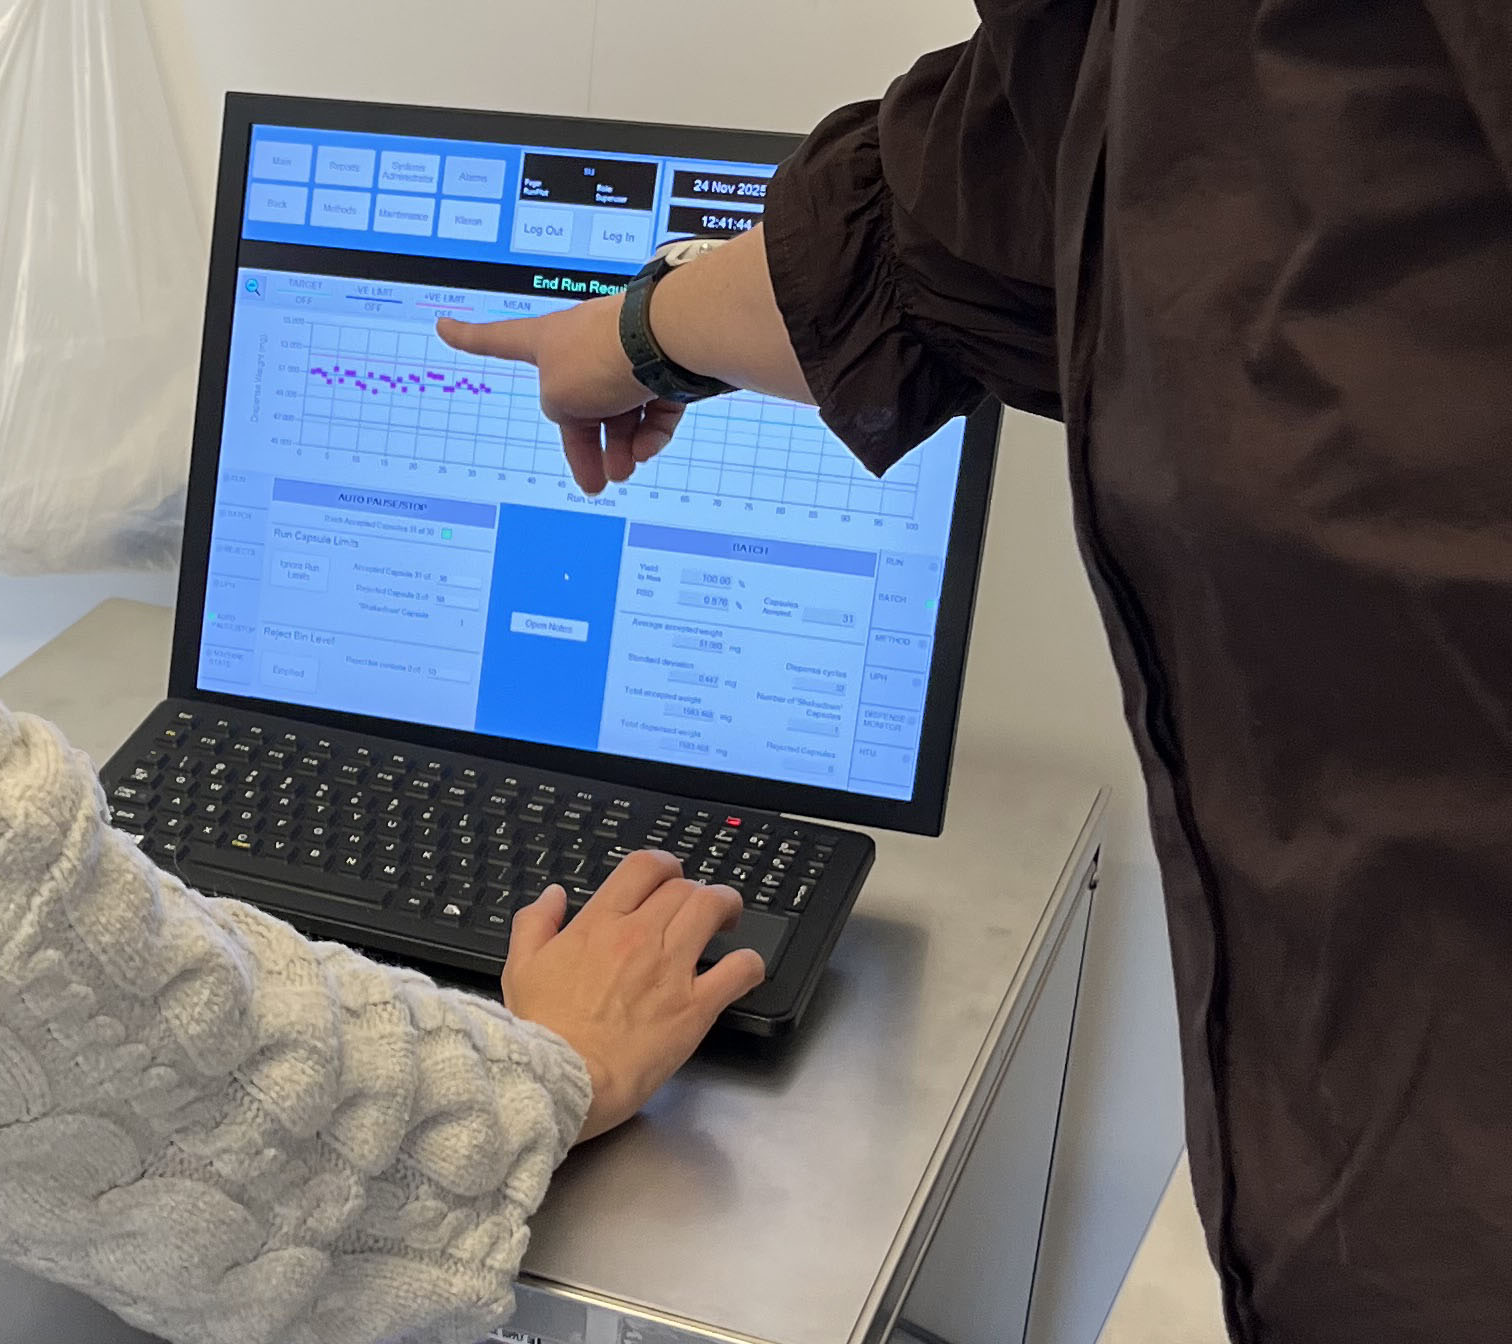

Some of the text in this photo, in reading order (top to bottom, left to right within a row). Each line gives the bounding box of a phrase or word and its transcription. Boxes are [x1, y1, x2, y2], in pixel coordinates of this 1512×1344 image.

[693, 180, 767, 196] 24 Nov 2025
[267, 199, 287, 209] Back
[324, 204, 356, 215] Methods
[702, 216, 752, 230] 12:41:44
[524, 224, 563, 236] Log Out
[603, 231, 634, 243] Log In
[288, 279, 322, 290] TARGET
[533, 275, 629, 296] End Run Requi
[372, 287, 392, 296] LIMIT
[444, 294, 465, 303] LIMIT
[504, 301, 531, 310] MEAN
[338, 493, 364, 504] AUTO
[567, 493, 585, 505] Run
[274, 529, 359, 548] Run Capsule Limits
[878, 593, 906, 603] BATCH
[264, 627, 335, 645] Reject Bin Level
